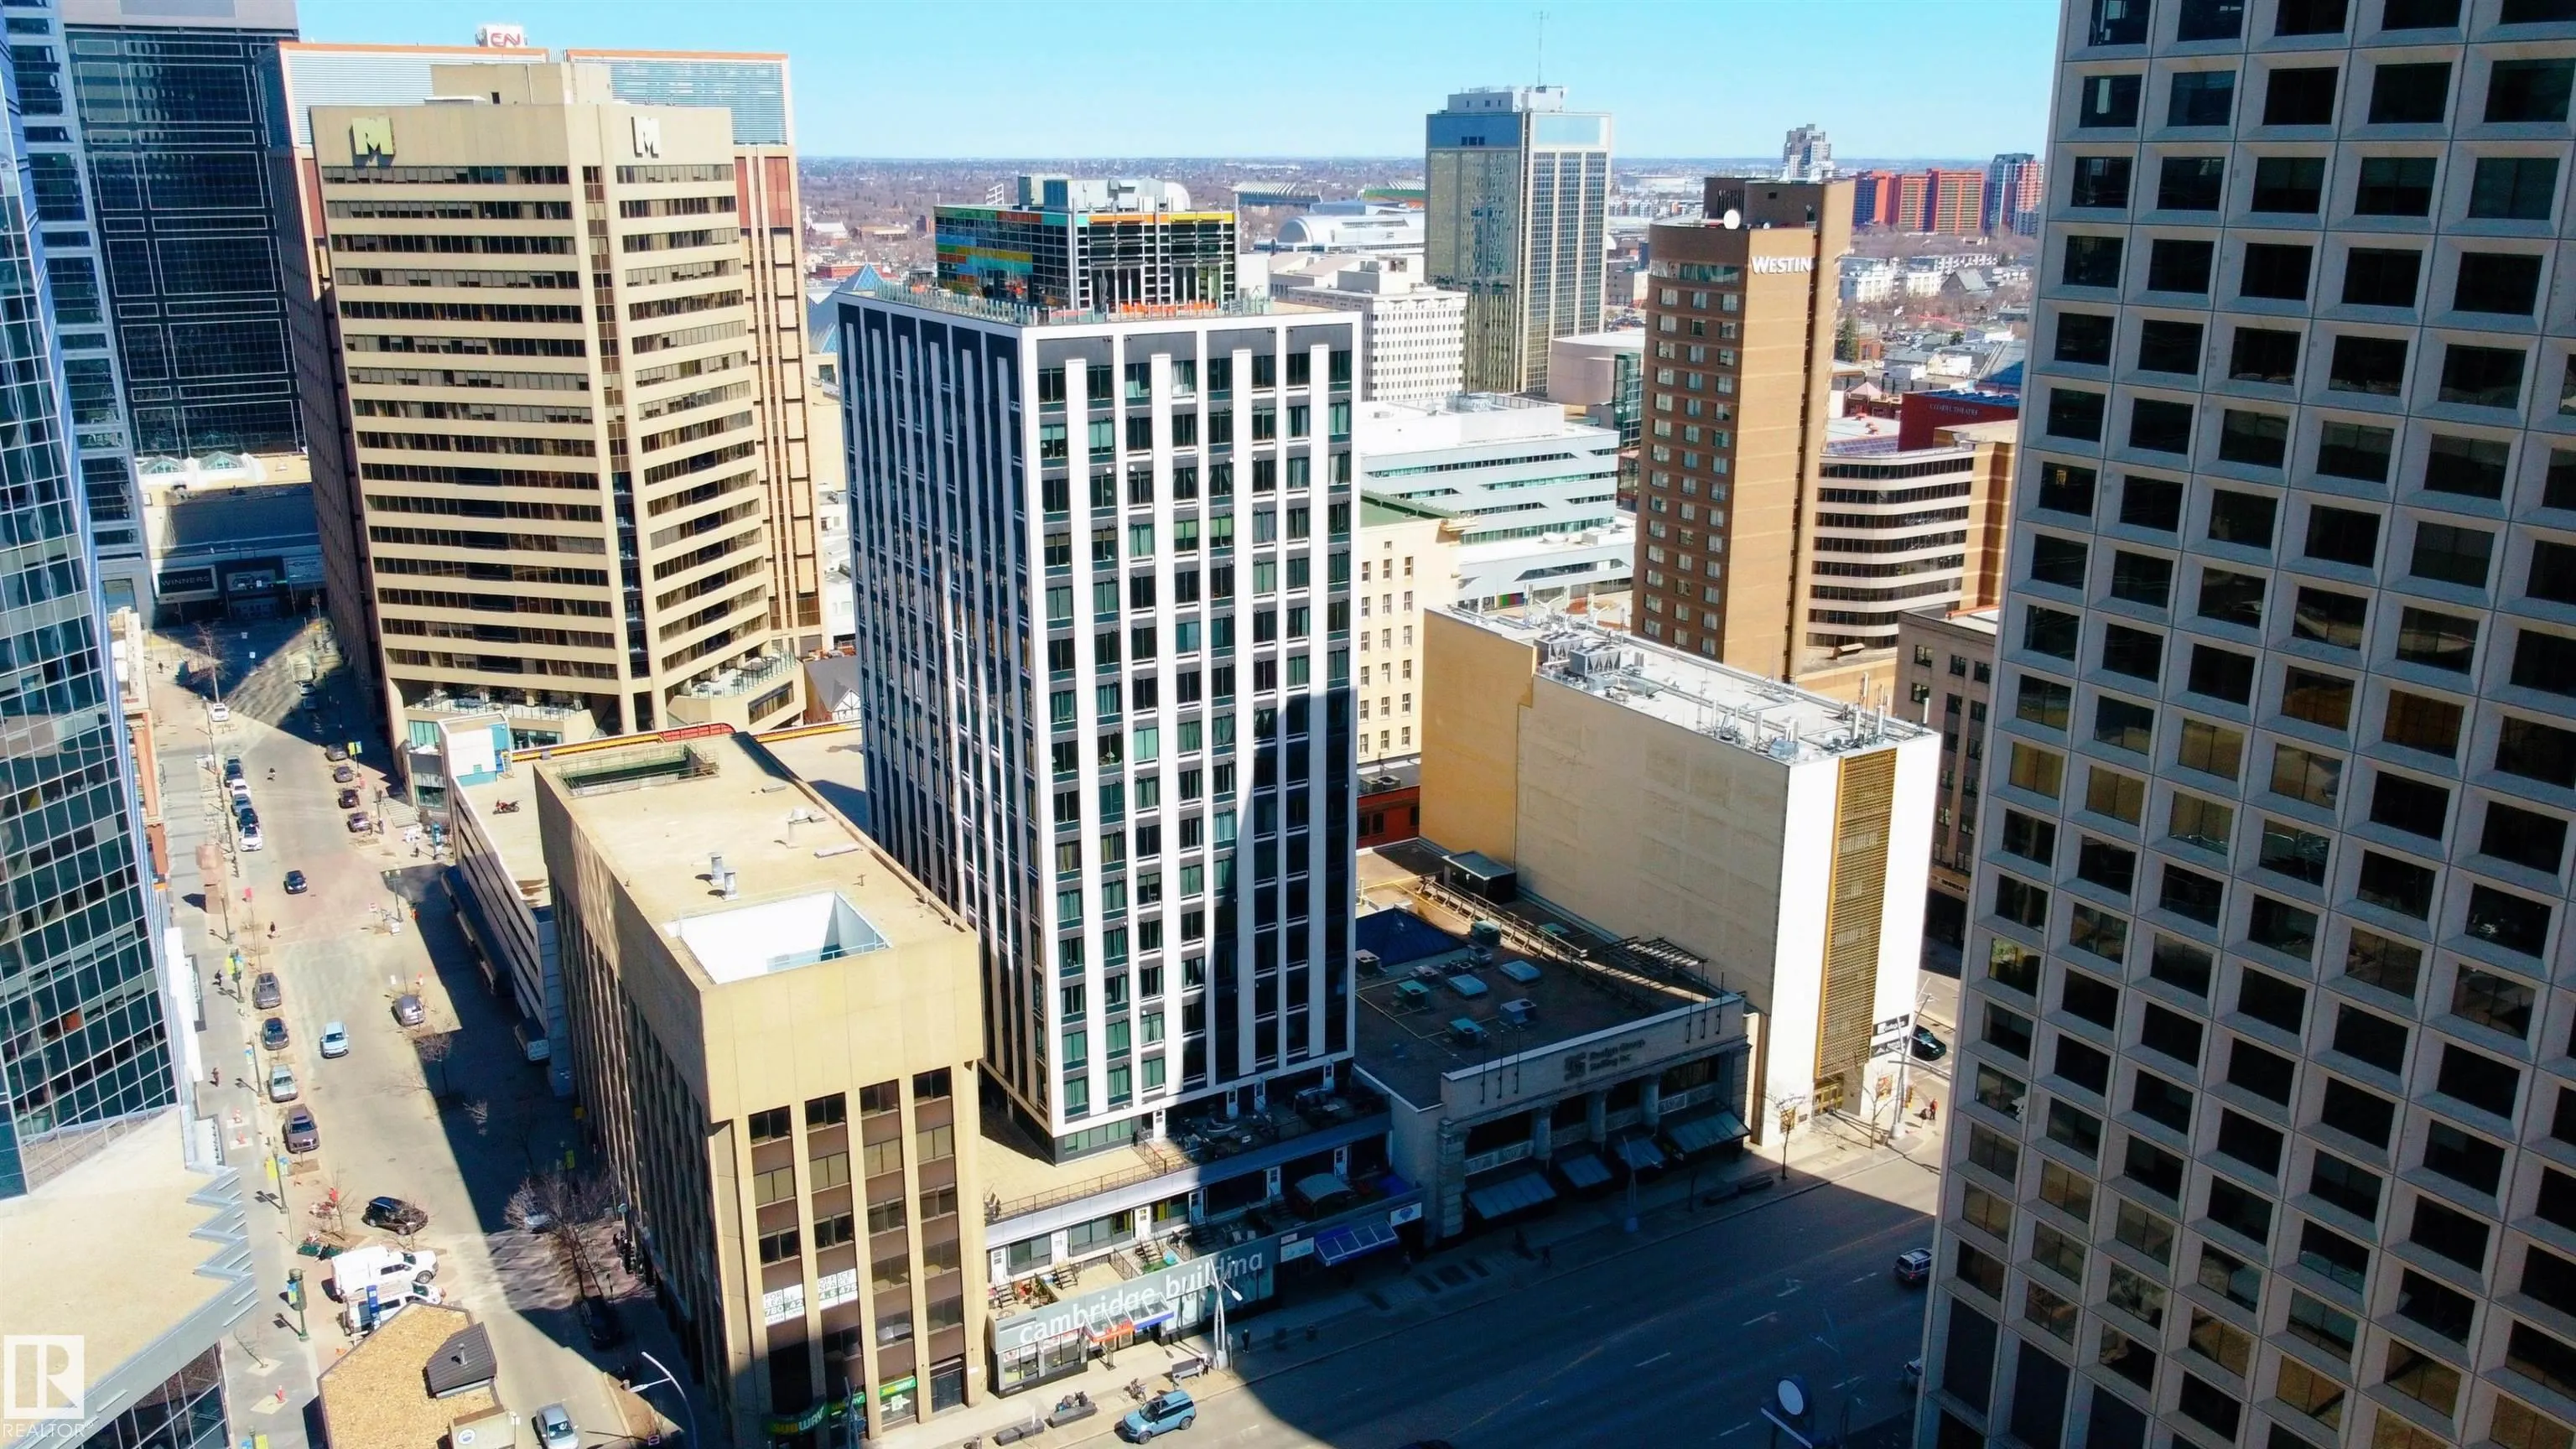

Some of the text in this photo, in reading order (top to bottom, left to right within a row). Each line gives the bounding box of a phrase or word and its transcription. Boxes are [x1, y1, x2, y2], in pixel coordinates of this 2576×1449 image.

[491, 32, 521, 47] CN
[1751, 255, 1813, 274] WESTIN
[160, 575, 210, 586] WINNERS
[818, 1271, 852, 1285] OFFICE
[818, 1278, 851, 1292] SPACE
[765, 1291, 782, 1301] FOR
[766, 1294, 794, 1307] LEASE
[1019, 1286, 1156, 1343] cambridge
[882, 1380, 912, 1394] SUBWAY
[773, 1405, 824, 1433] SUBWAY
